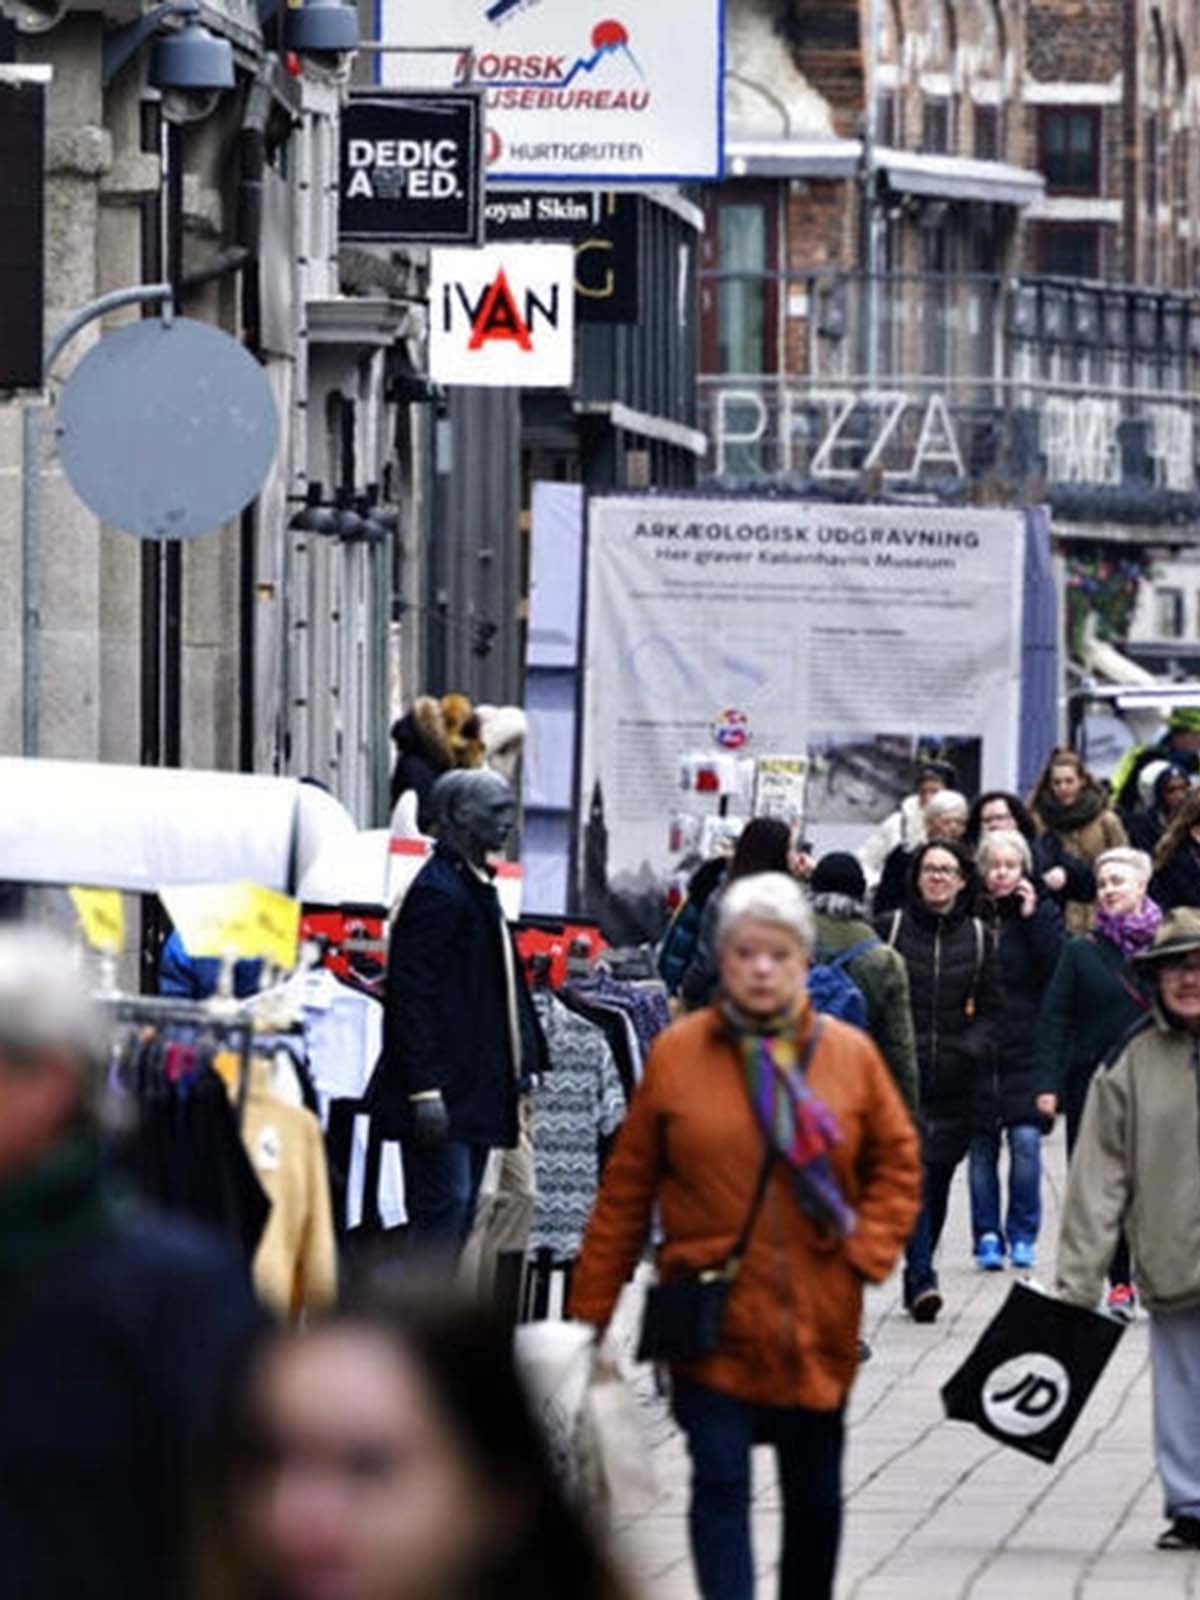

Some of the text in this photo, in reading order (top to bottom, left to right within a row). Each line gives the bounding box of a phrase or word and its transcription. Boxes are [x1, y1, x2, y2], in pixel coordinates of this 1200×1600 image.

[349, 139, 457, 168] DEDIC
[509, 143, 642, 161] HURTIGRUTEN
[485, 198, 589, 223] oyal Skin
[442, 265, 558, 351] IVAN
[634, 522, 980, 549] ARKÆOLOGISK UDGRAVNING
[991, 1372, 1059, 1417] JD
